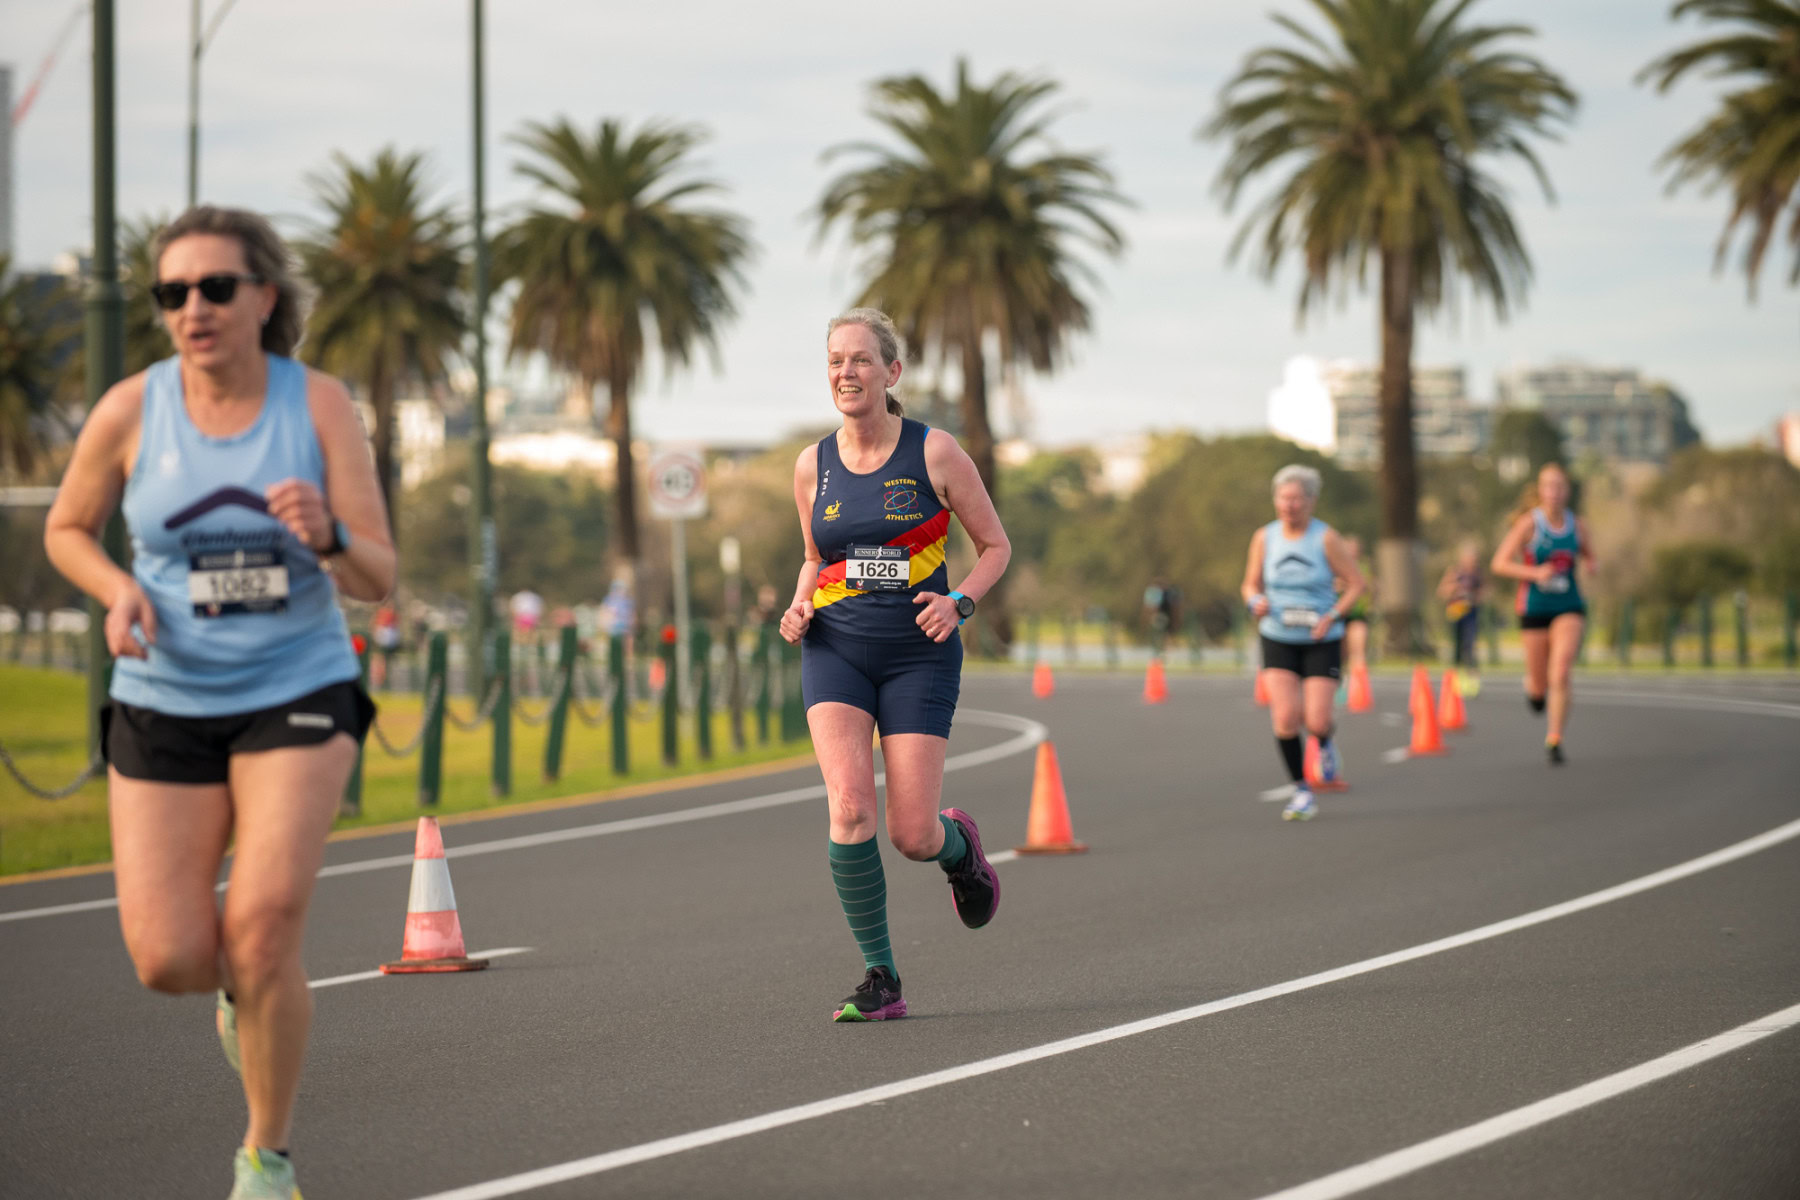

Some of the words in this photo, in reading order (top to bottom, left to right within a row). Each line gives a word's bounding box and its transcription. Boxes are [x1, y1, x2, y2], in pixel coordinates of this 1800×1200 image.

[883, 478, 917, 488] WESTERN
[885, 512, 923, 521] ATHLETICS
[882, 549, 902, 558] WORLD
[857, 561, 898, 577] 1626
